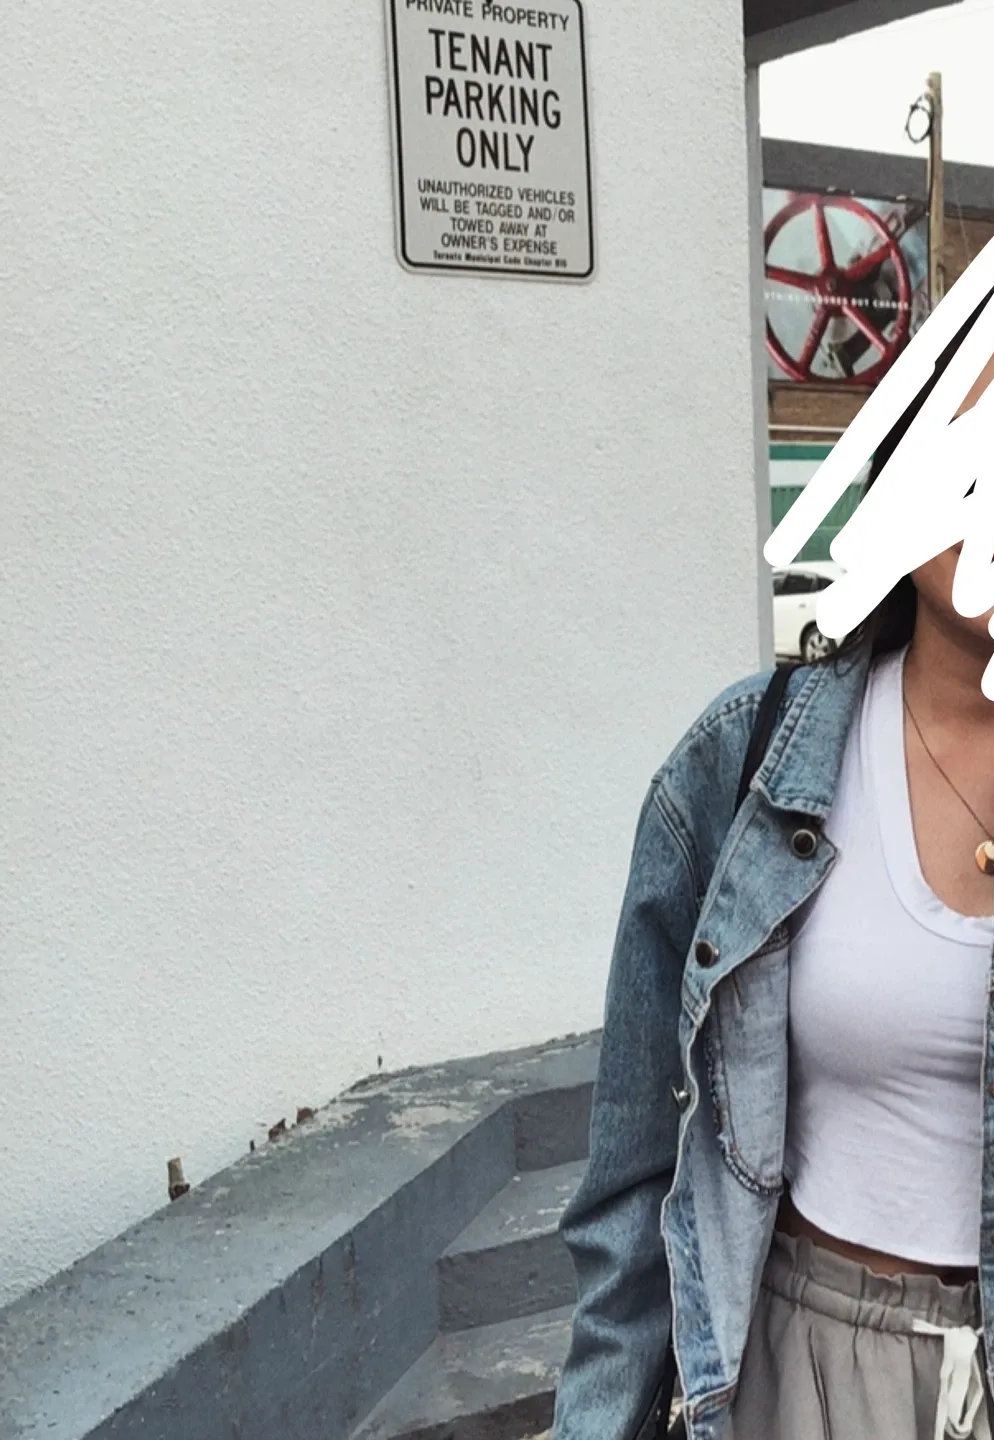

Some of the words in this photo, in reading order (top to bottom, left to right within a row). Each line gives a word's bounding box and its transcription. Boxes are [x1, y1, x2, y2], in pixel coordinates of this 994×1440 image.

[482, 3, 570, 31] PROPERTY
[428, 28, 553, 82] TENANT
[425, 75, 561, 130] PARKING
[456, 127, 535, 173] ONLY
[417, 178, 514, 201] UNAUTHORIZED
[518, 187, 575, 206] VEHICLES
[419, 196, 449, 213] WILL
[454, 200, 470, 214] BE
[475, 201, 523, 219] TAGGED
[450, 217, 494, 234] TOWED
[499, 221, 529, 237] AWAY
[534, 224, 548, 238] AT
[441, 233, 499, 251] OWNER'S
[503, 237, 557, 256] EXPENSE
